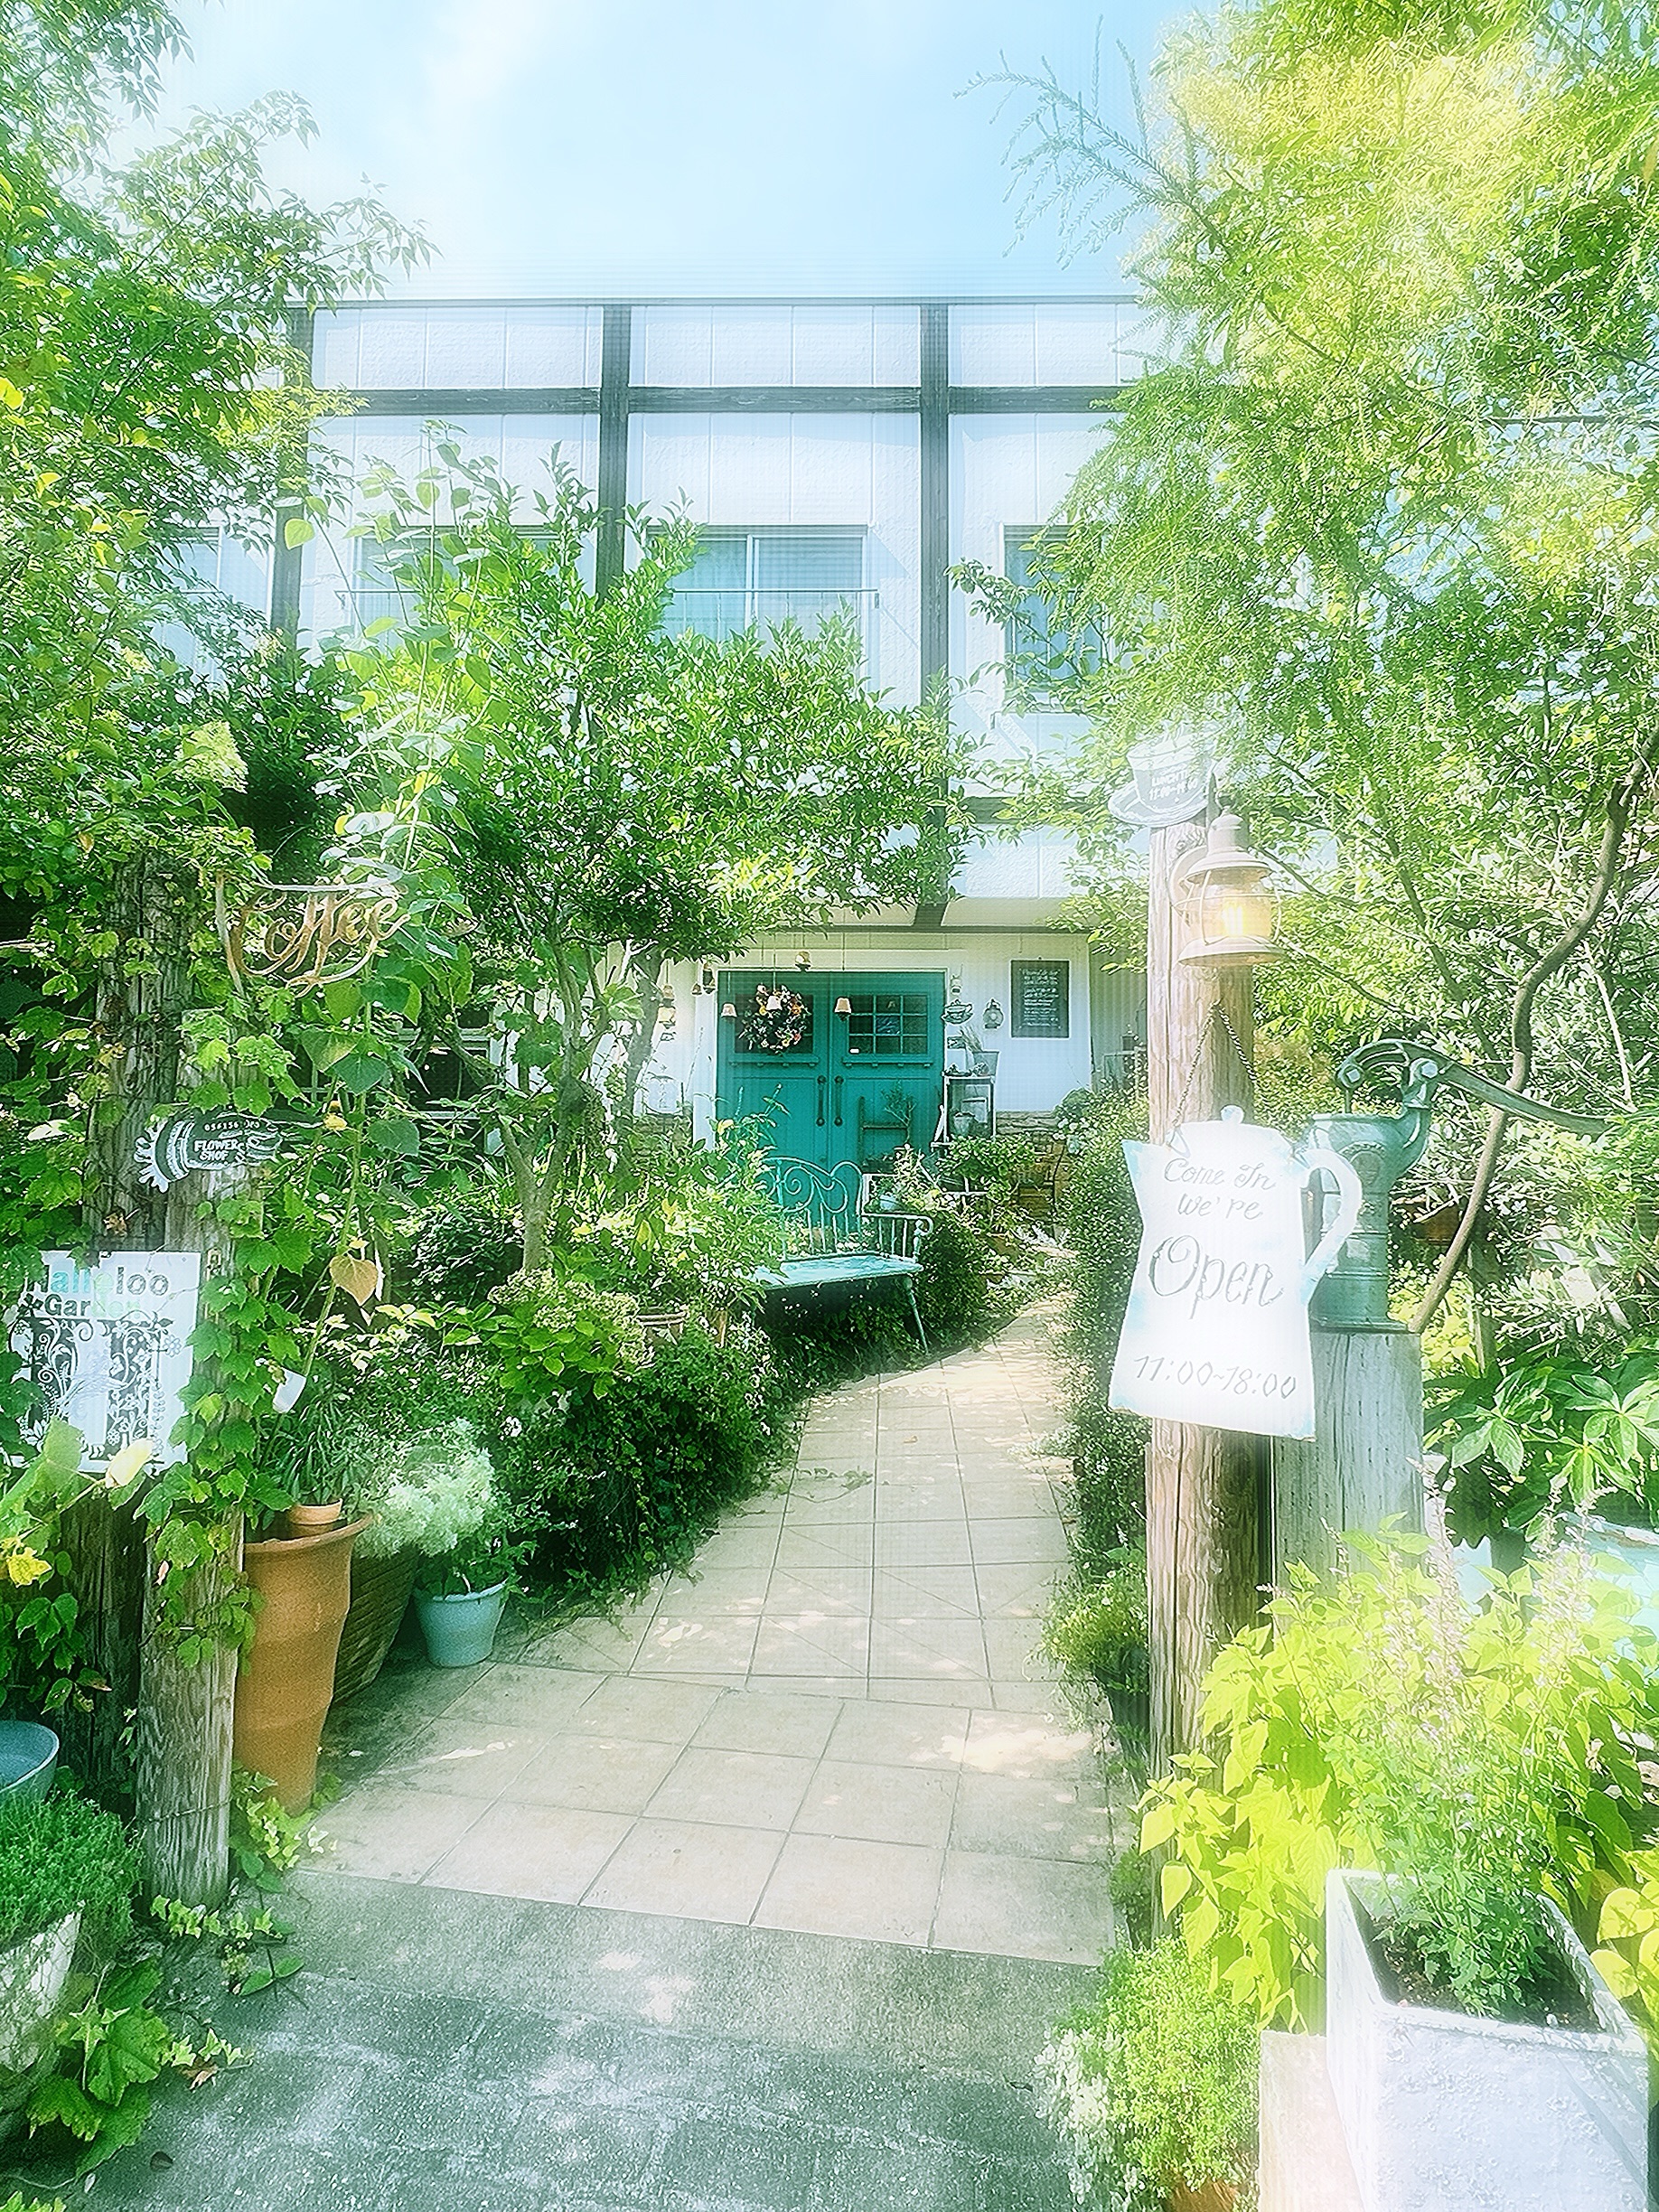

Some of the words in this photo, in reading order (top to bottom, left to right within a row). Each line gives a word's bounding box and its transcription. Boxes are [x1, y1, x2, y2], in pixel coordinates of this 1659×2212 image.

[230, 878, 411, 978] Coffee
[193, 1139, 239, 1152] FLOWER
[1164, 1158, 1225, 1185] Come
[1233, 1162, 1276, 1191] In
[1148, 1234, 1285, 1320] Open
